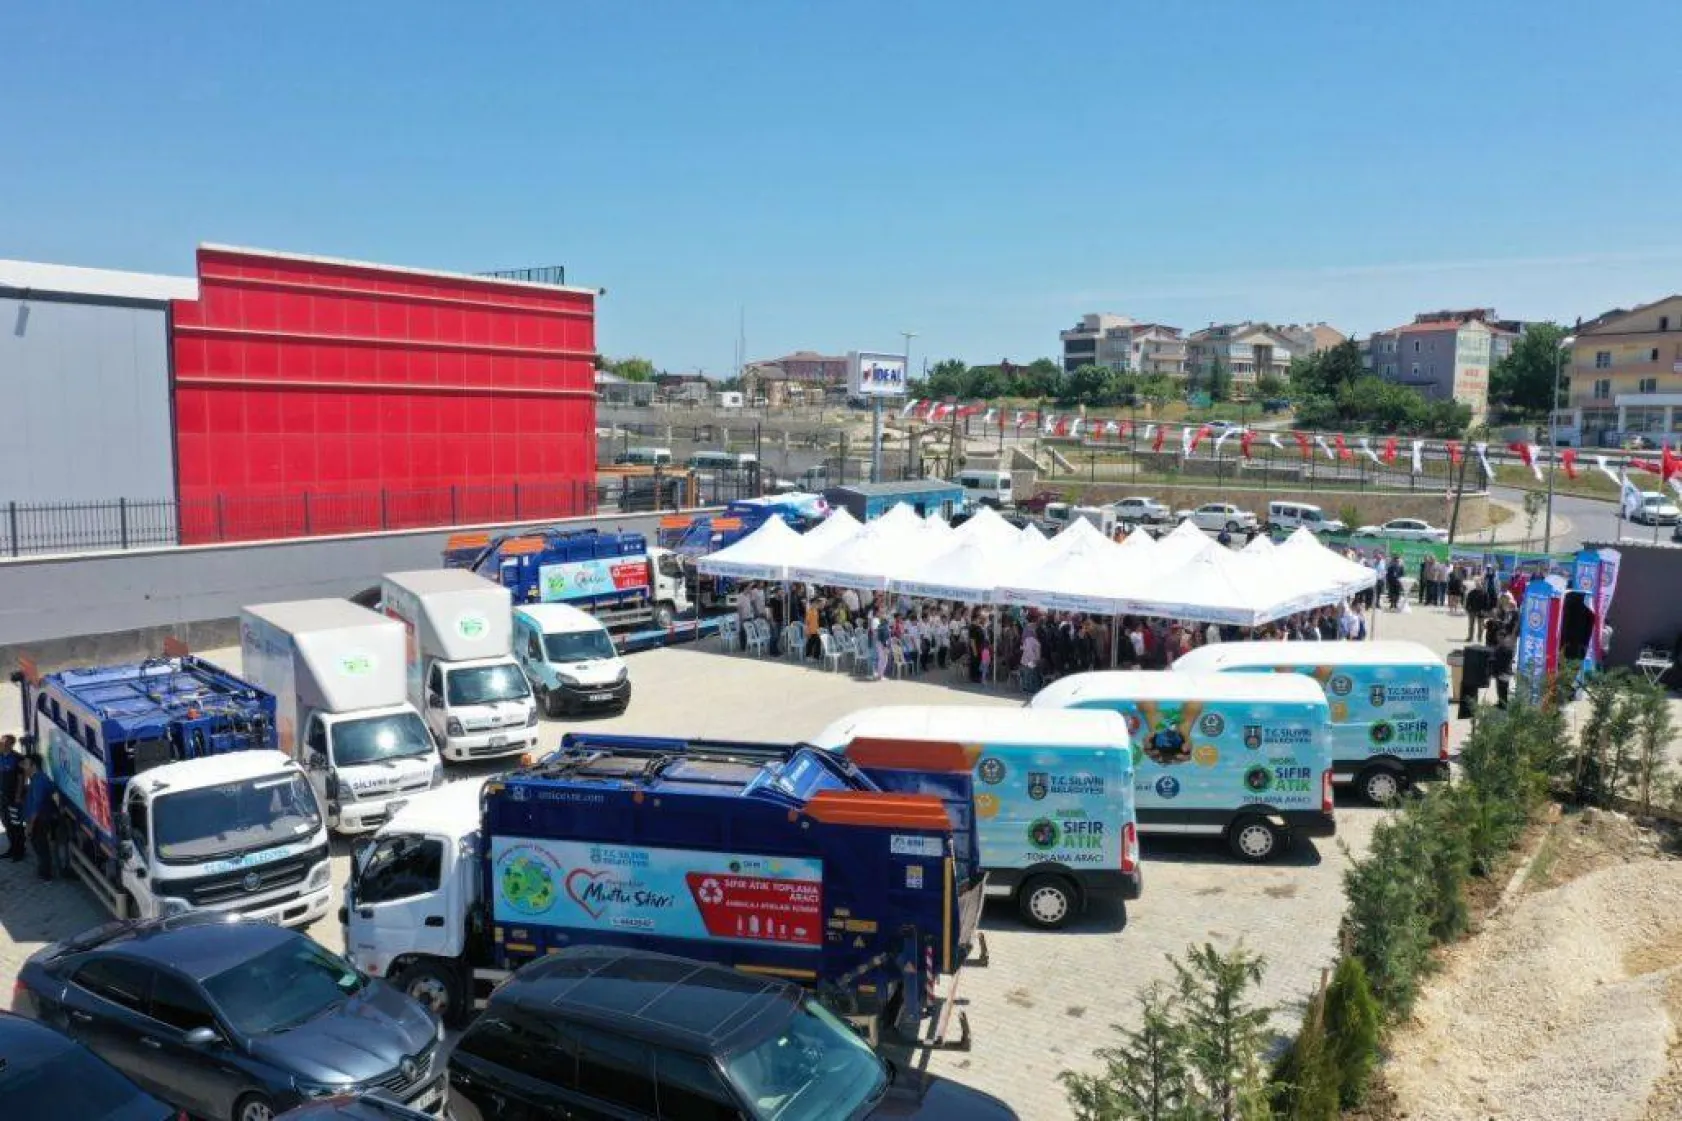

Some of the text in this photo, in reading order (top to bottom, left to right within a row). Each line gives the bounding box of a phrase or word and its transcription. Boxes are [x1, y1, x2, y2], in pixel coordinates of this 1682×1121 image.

[1397, 722, 1428, 732] SIFIR
[1275, 767, 1312, 779] SIFIR
[1275, 779, 1312, 792] ATIK
[1063, 821, 1104, 834] SIFIR
[1063, 835, 1103, 849] ATIK
